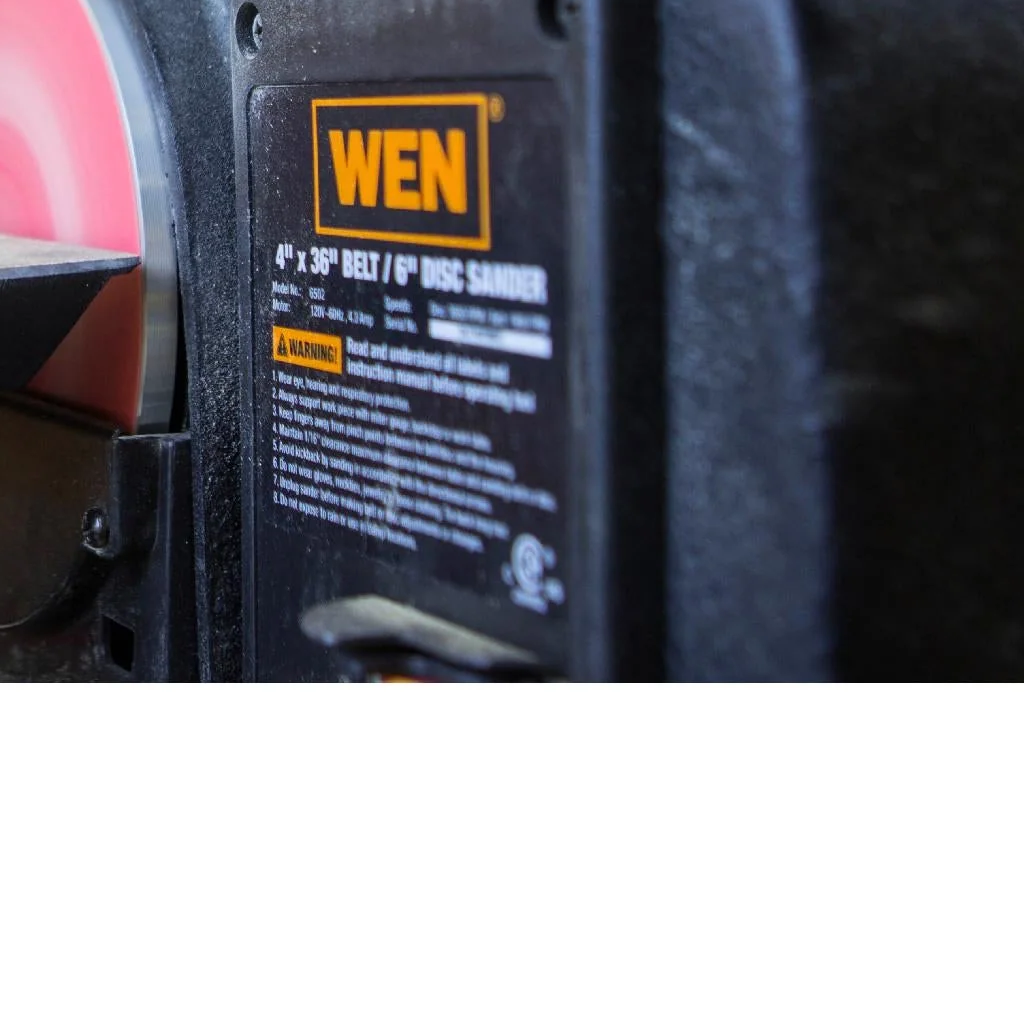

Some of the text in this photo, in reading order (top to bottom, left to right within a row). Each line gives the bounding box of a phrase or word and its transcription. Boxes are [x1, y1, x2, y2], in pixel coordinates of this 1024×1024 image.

[328, 128, 468, 215] WEN
[276, 242, 294, 270] 4"
[297, 250, 307, 273] x
[310, 245, 338, 276] 36"
[342, 247, 380, 282] BELT
[393, 253, 418, 287] 6"
[420, 255, 464, 295] DISC
[466, 258, 549, 306] SANDER
[288, 338, 338, 364] WARNING!
[346, 335, 369, 357] Read
[370, 342, 388, 361] and
[278, 371, 293, 386] Wear
